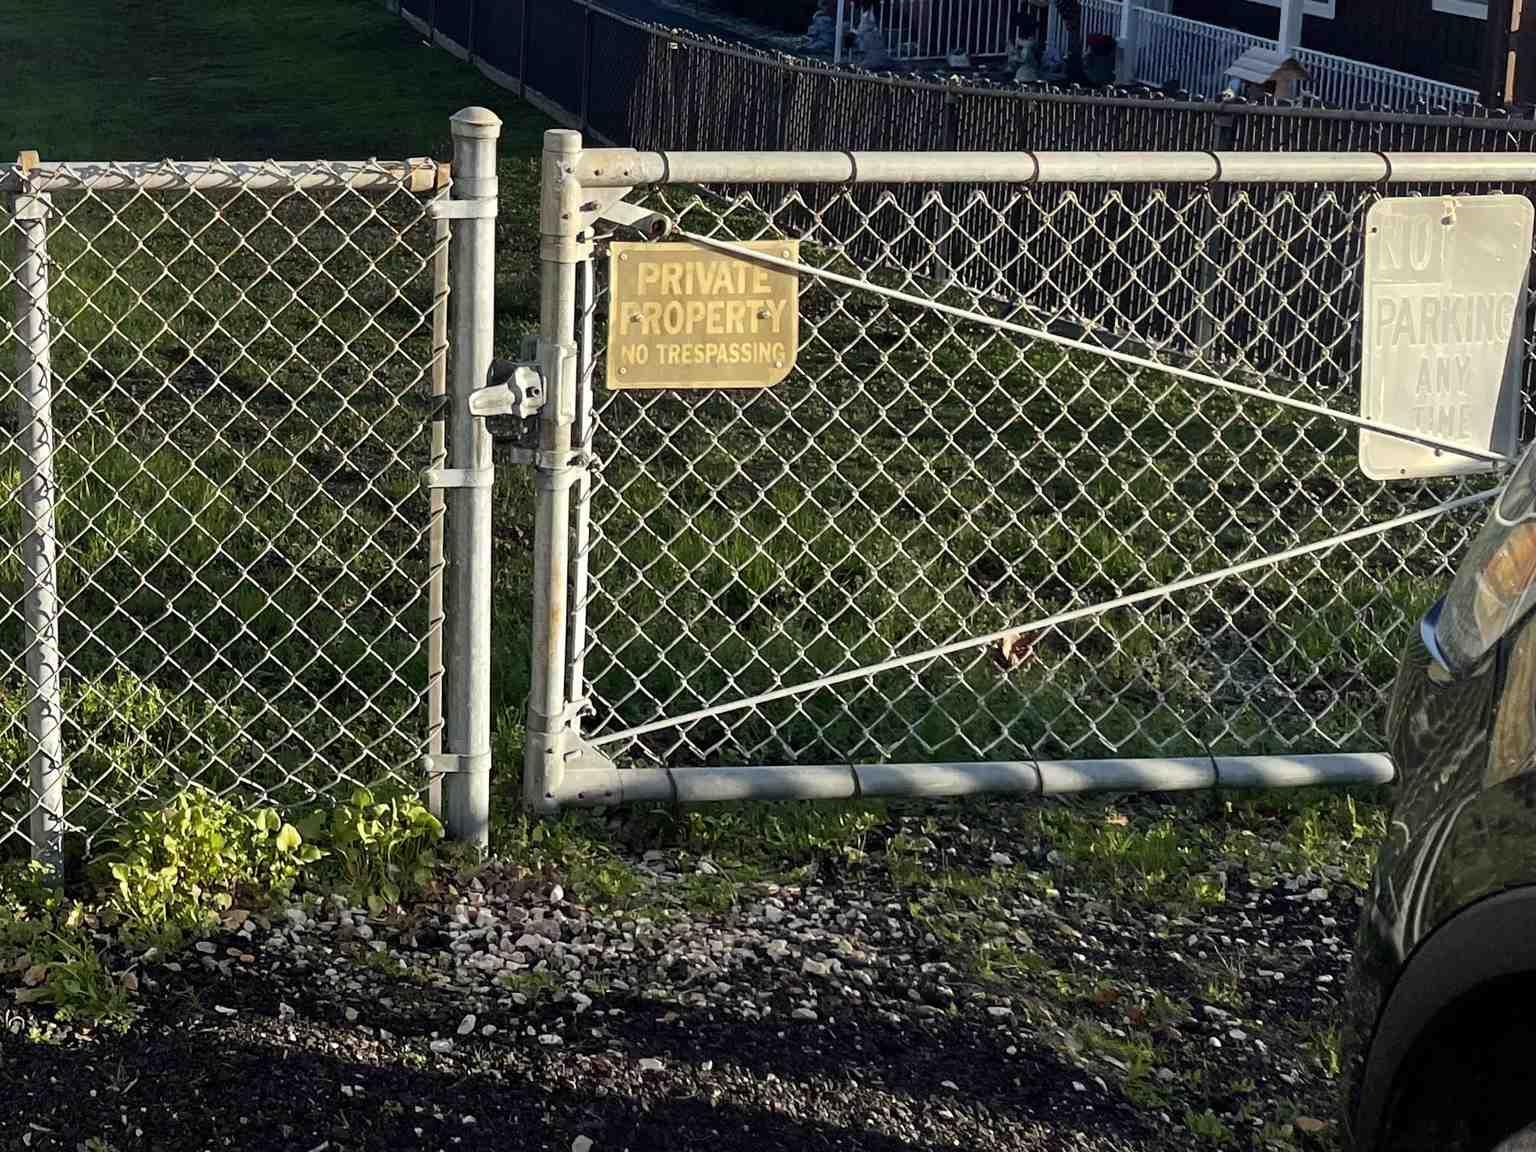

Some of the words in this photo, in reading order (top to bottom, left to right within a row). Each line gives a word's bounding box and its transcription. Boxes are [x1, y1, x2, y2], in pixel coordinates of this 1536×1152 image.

[637, 261, 772, 296] PRIVATE
[619, 299, 787, 336] PROPERTY
[1376, 294, 1513, 347] PARKING
[622, 344, 649, 365] NO
[656, 342, 786, 365] TRESPASSING
[1417, 354, 1472, 394] ANY
[1415, 404, 1472, 439] TIME
